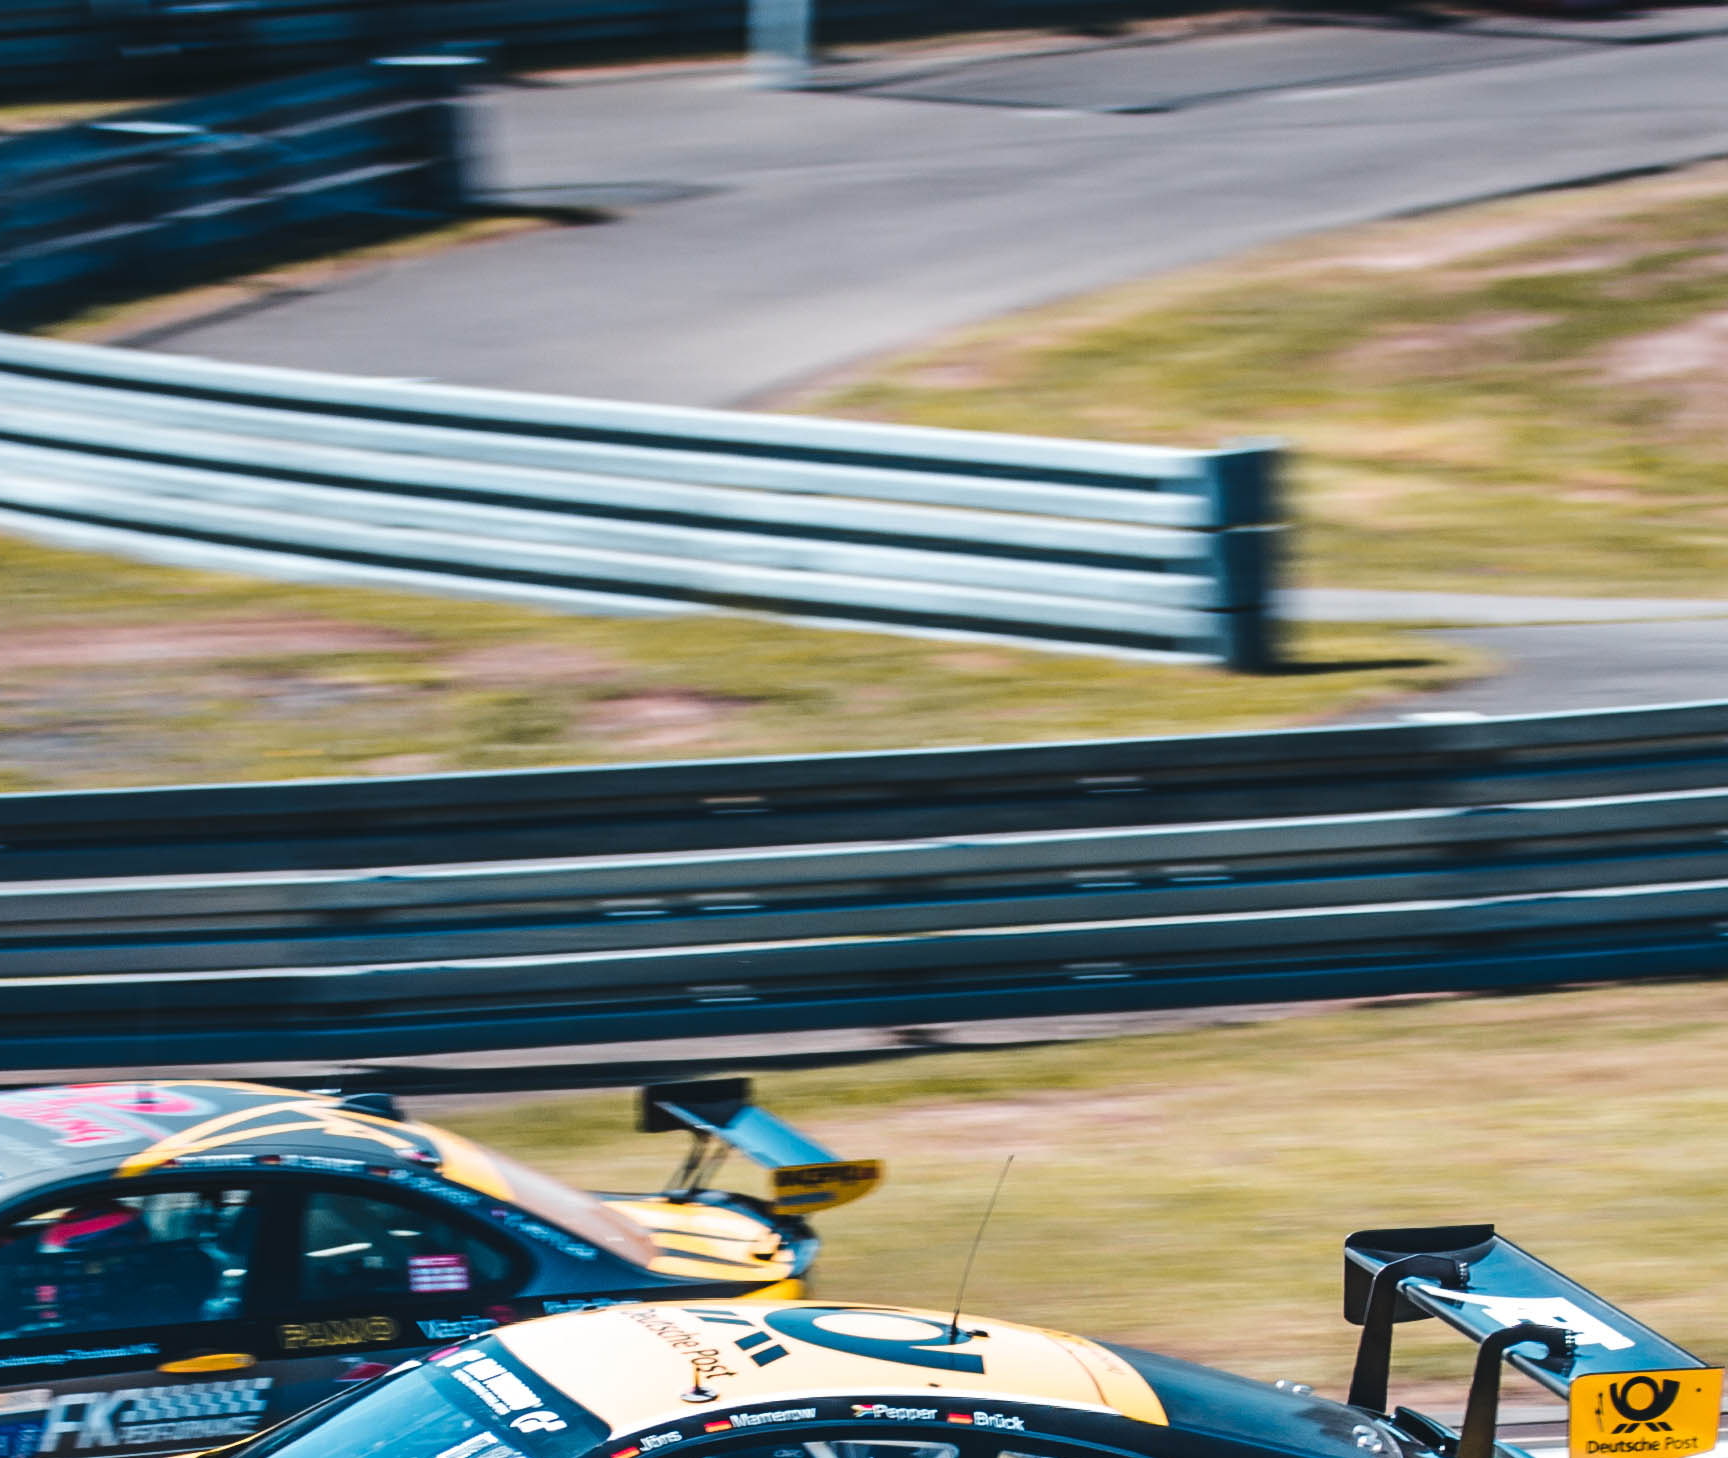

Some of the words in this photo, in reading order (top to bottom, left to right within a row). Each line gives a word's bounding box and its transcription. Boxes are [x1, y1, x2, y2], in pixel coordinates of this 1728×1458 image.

[680, 1347, 737, 1381] Post
[873, 1402, 939, 1422] Pepper
[973, 1410, 1026, 1432] Brück
[1586, 1436, 1661, 1455] Deutsche
[1663, 1435, 1699, 1451] Post
